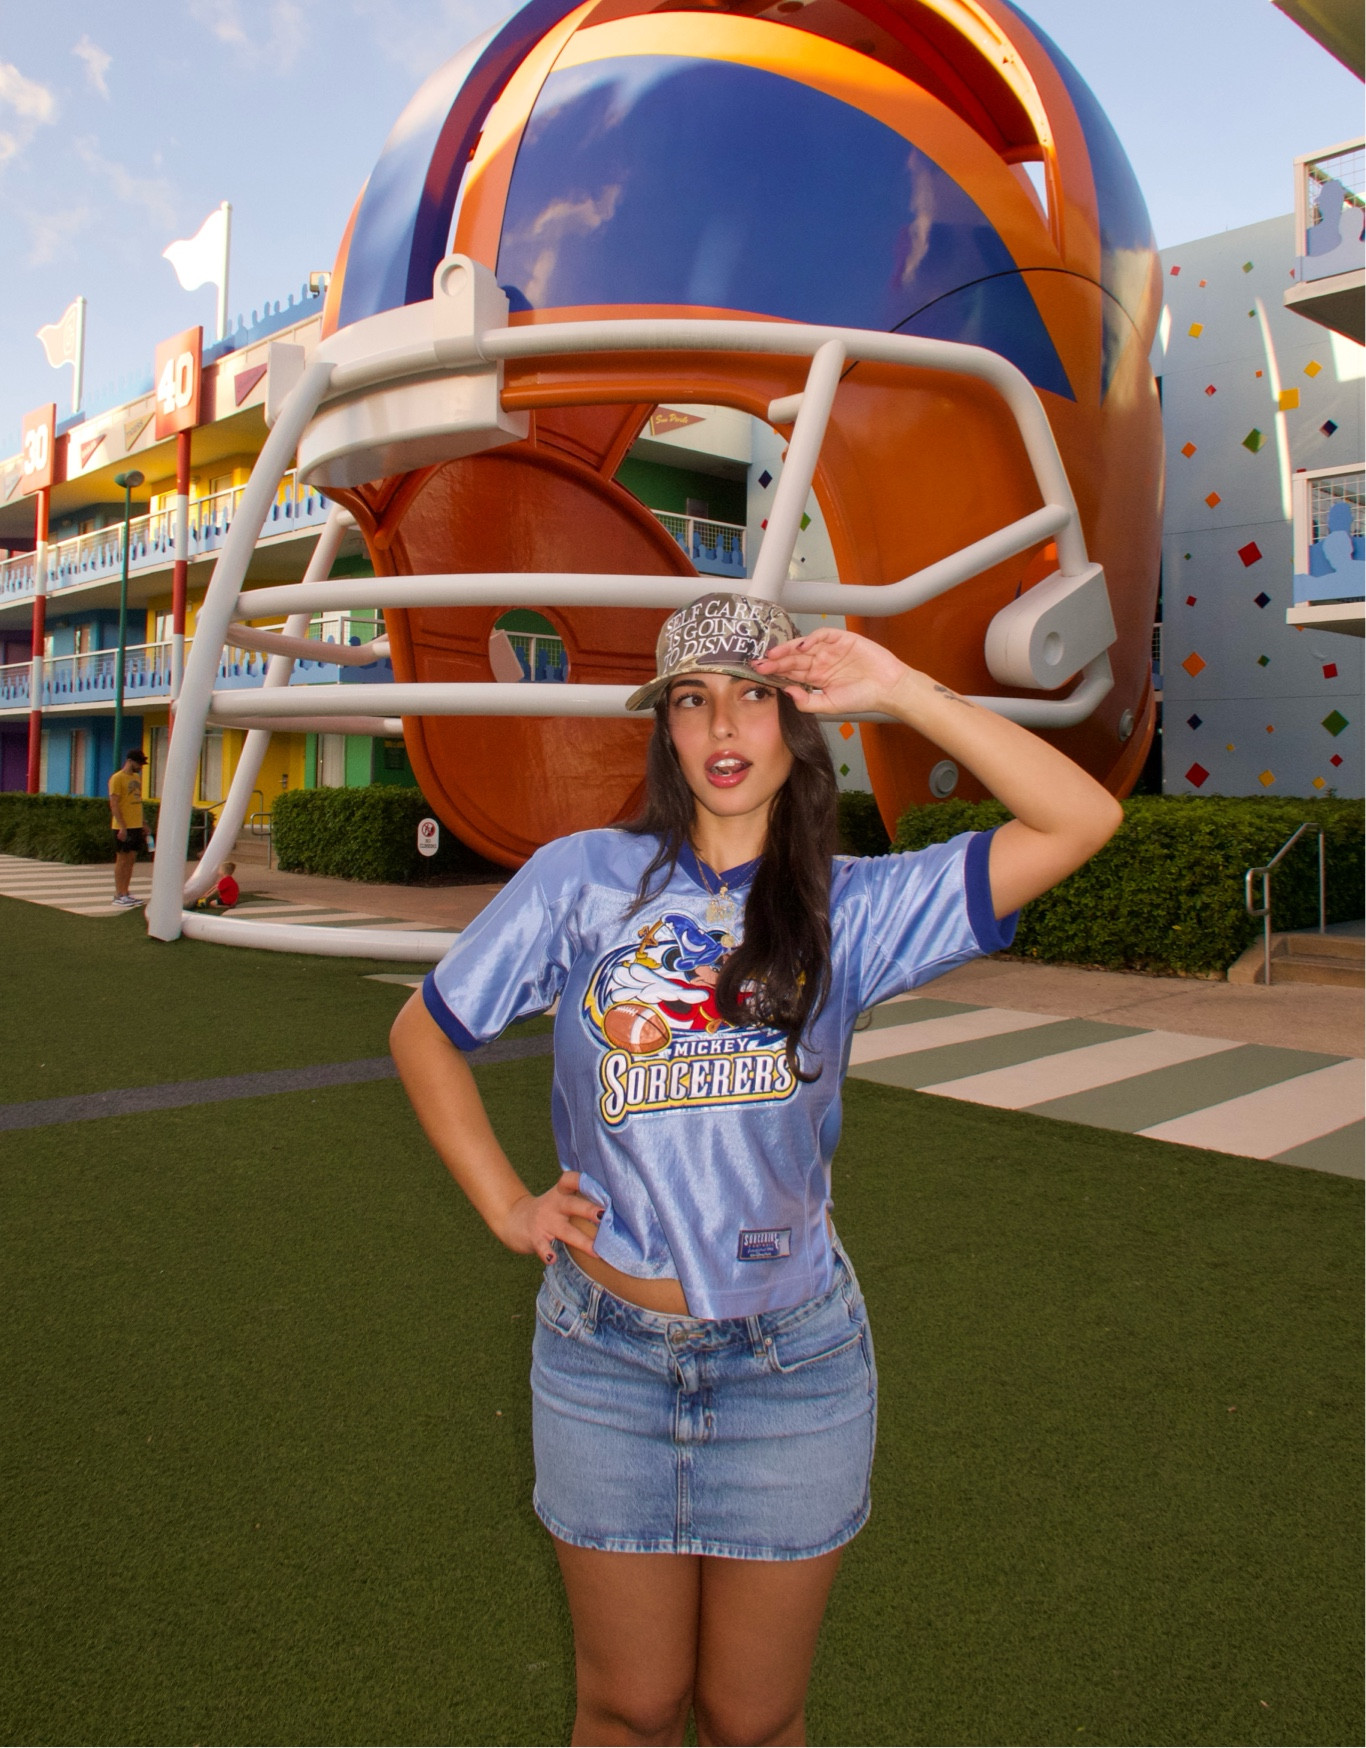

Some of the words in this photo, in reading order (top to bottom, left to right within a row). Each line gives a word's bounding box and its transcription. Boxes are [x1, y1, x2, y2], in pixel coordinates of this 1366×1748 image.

[158, 351, 194, 415] 40
[24, 424, 48, 475] 30
[665, 631, 682, 651] IS
[684, 617, 752, 640] GOING
[667, 603, 702, 631] SELF
[705, 600, 763, 620] CARE
[663, 647, 679, 674] TO
[681, 636, 765, 660] DISNEY
[674, 1038, 750, 1056] MICKEY
[604, 1053, 795, 1118] SORCERERS
